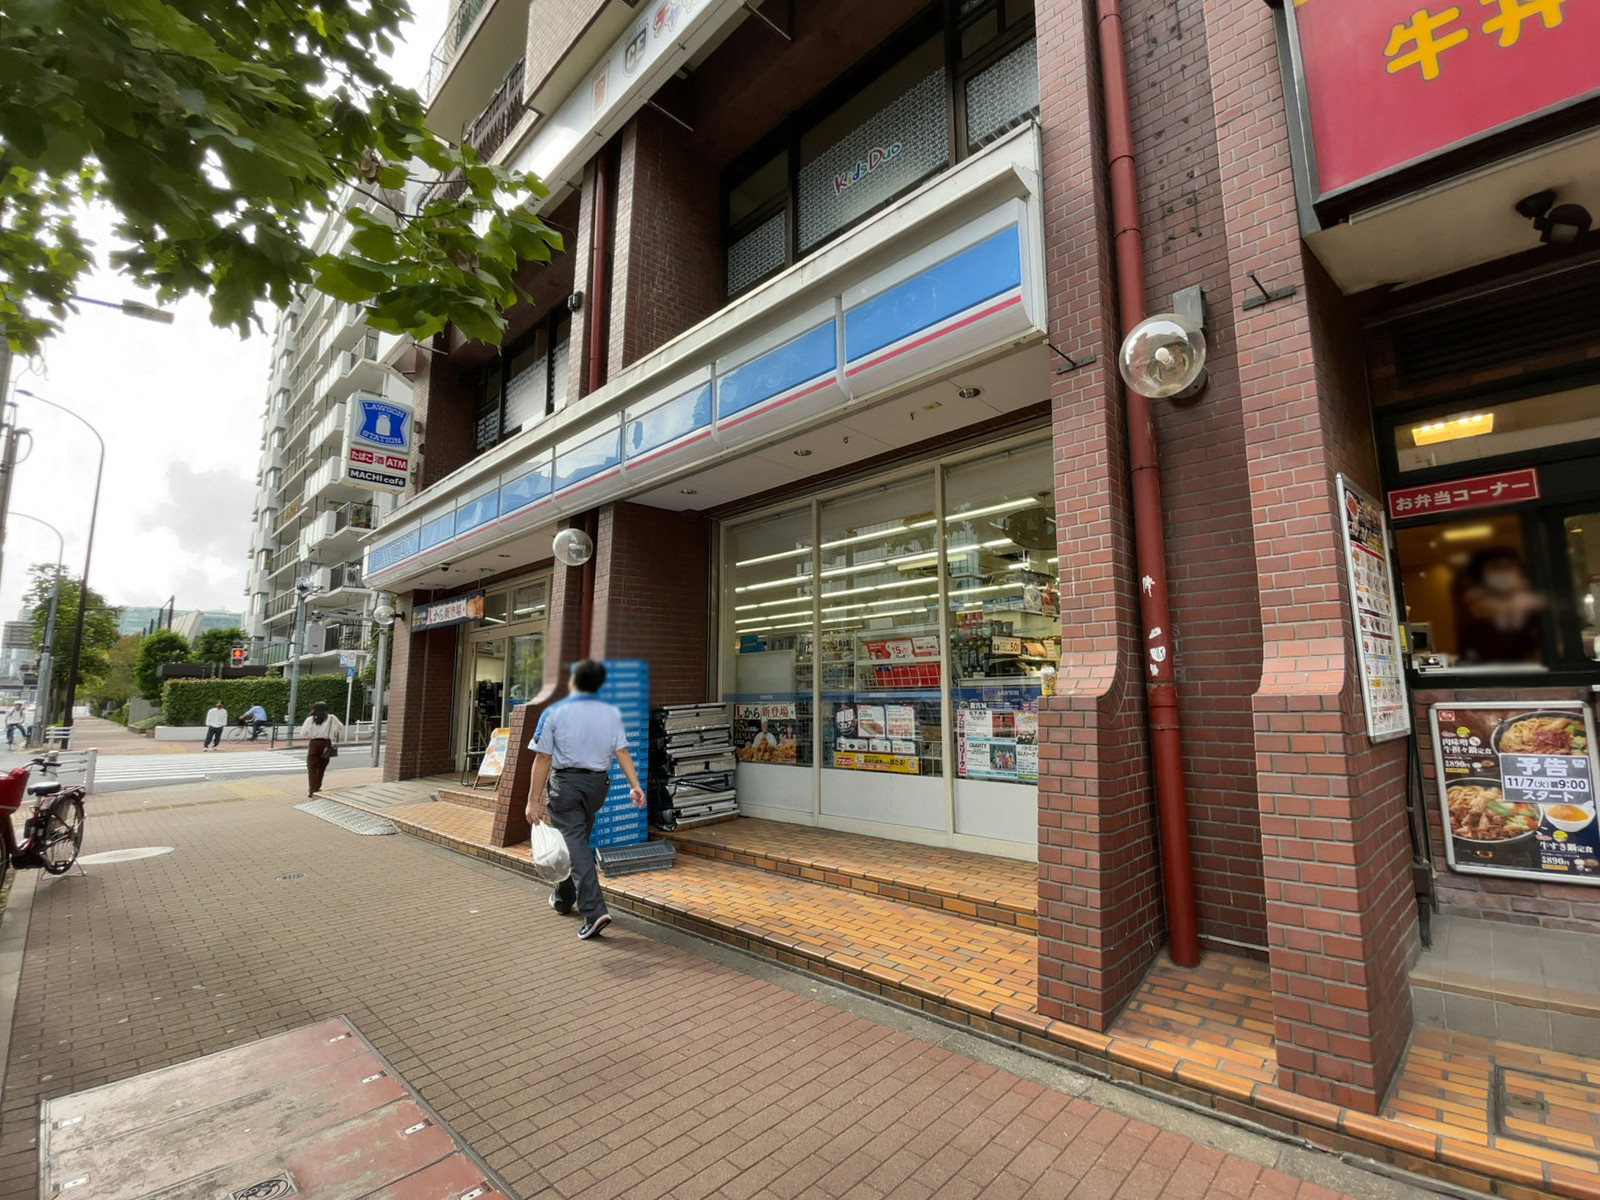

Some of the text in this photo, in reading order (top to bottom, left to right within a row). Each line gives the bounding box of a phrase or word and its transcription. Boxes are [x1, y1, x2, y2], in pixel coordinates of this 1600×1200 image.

[364, 403, 406, 418] LAWSON
[361, 430, 402, 444] STATION
[351, 450, 373, 463] たばこ
[386, 459, 407, 469] ATM
[350, 469, 383, 482] MACHI
[1396, 481, 1530, 511] お弁当コーナー
[1516, 757, 1568, 776] 予告
[1522, 790, 1574, 802] スタート
